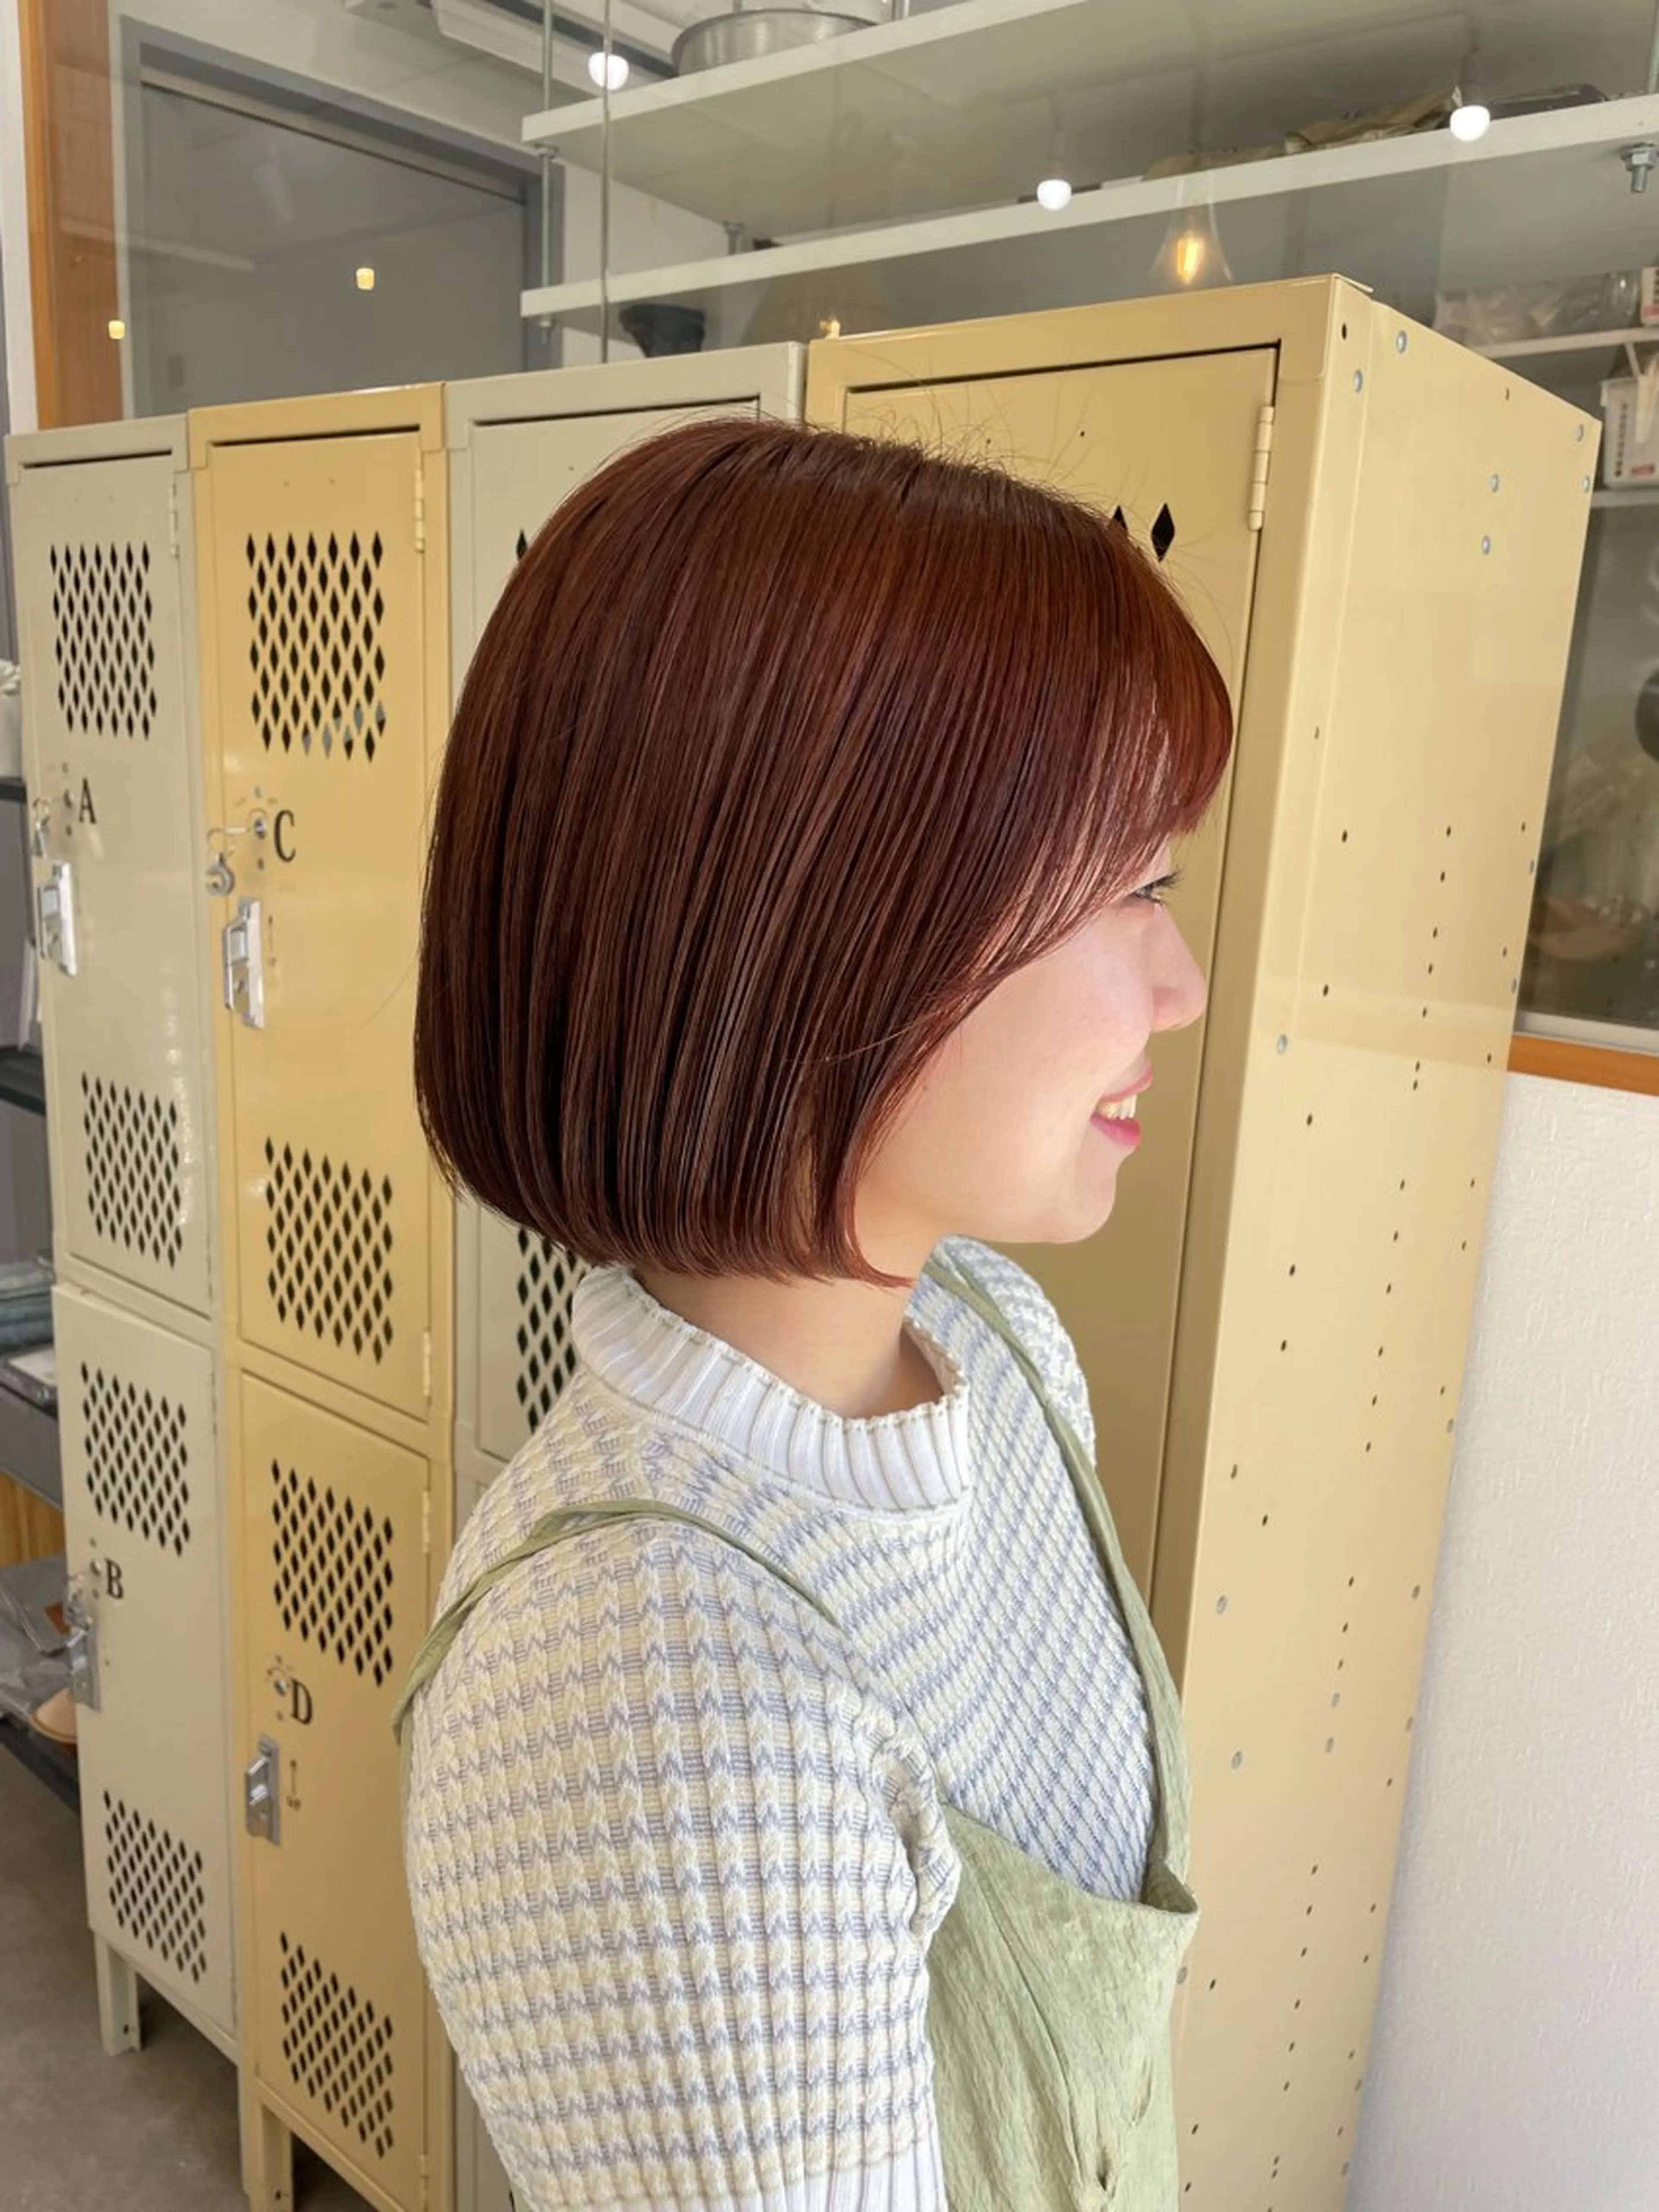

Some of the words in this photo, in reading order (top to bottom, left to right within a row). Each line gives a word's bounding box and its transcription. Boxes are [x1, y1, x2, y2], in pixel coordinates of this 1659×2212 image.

[79, 777, 97, 824] A
[273, 809, 296, 863] C
[104, 1557, 124, 1600] B
[290, 1677, 313, 1725] D
